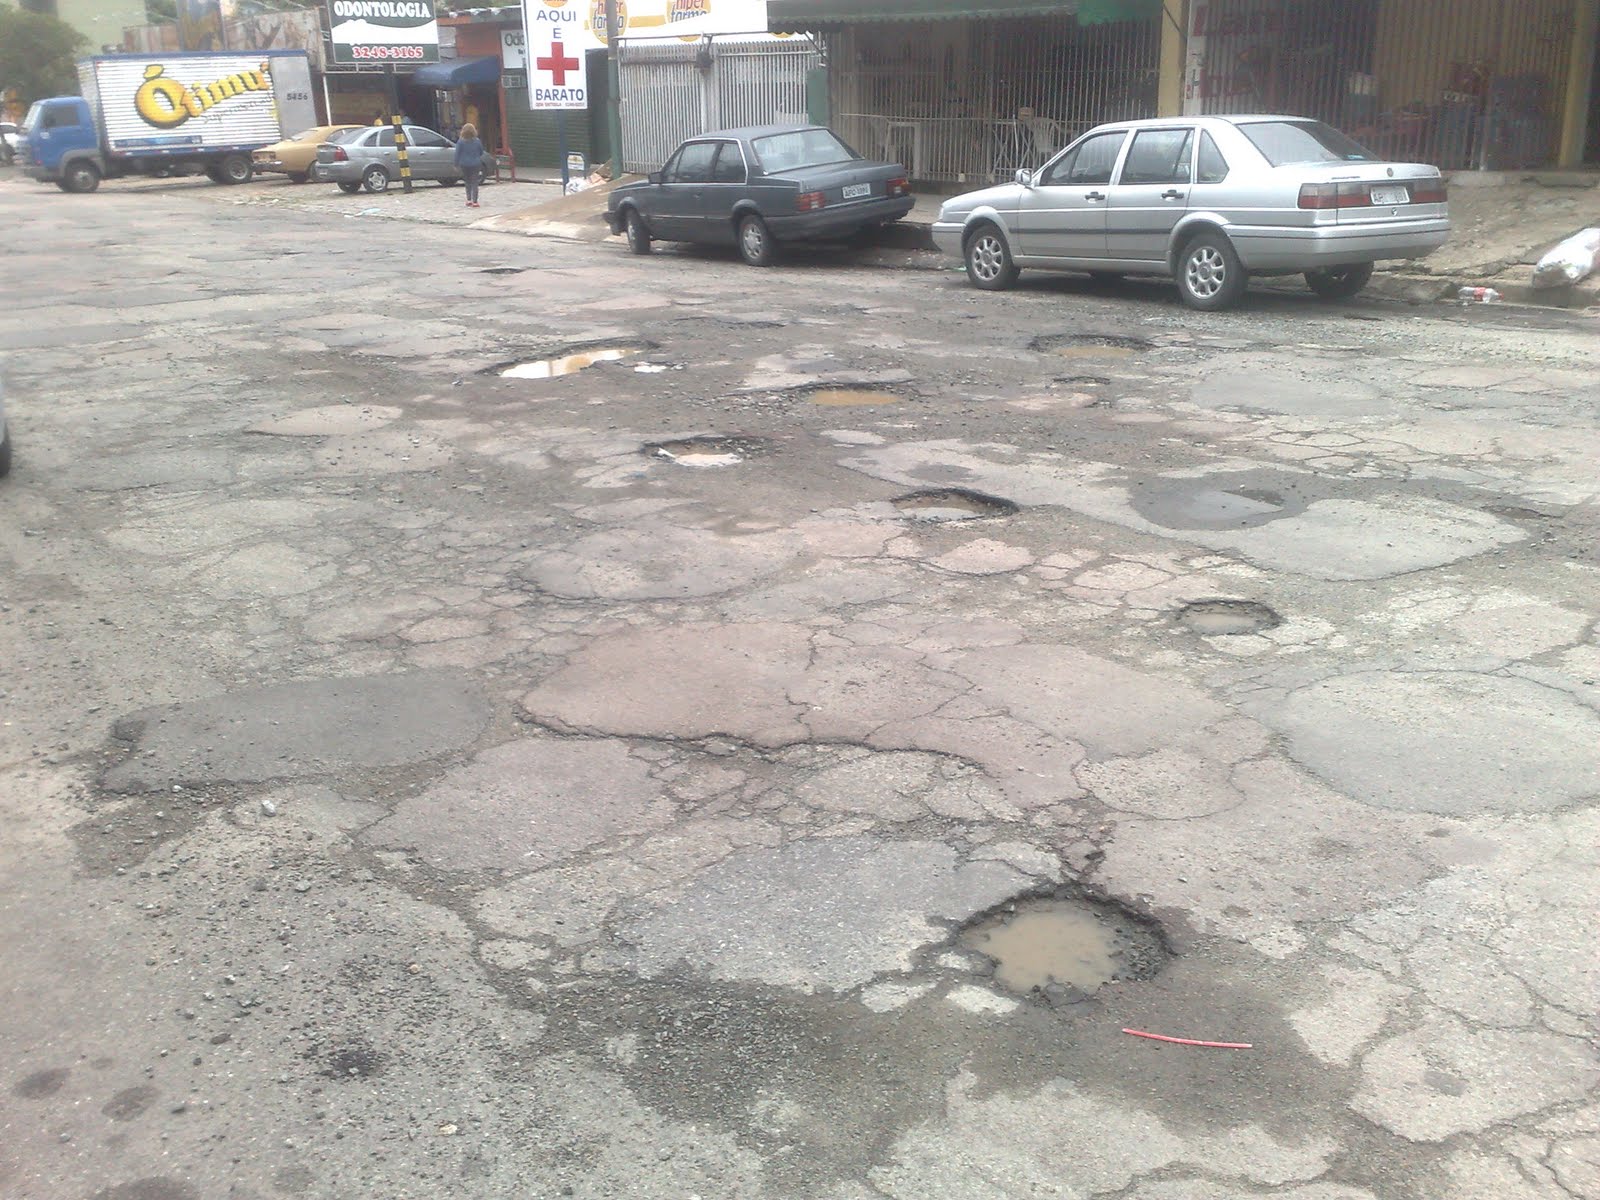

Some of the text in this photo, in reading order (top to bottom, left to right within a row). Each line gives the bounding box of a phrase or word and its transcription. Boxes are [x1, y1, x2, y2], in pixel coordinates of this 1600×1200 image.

[334, 1, 431, 18] ODONTOLOGIA
[536, 10, 577, 22] AQUI
[352, 46, 424, 58] 3248-3165
[535, 88, 584, 101] BARATO
